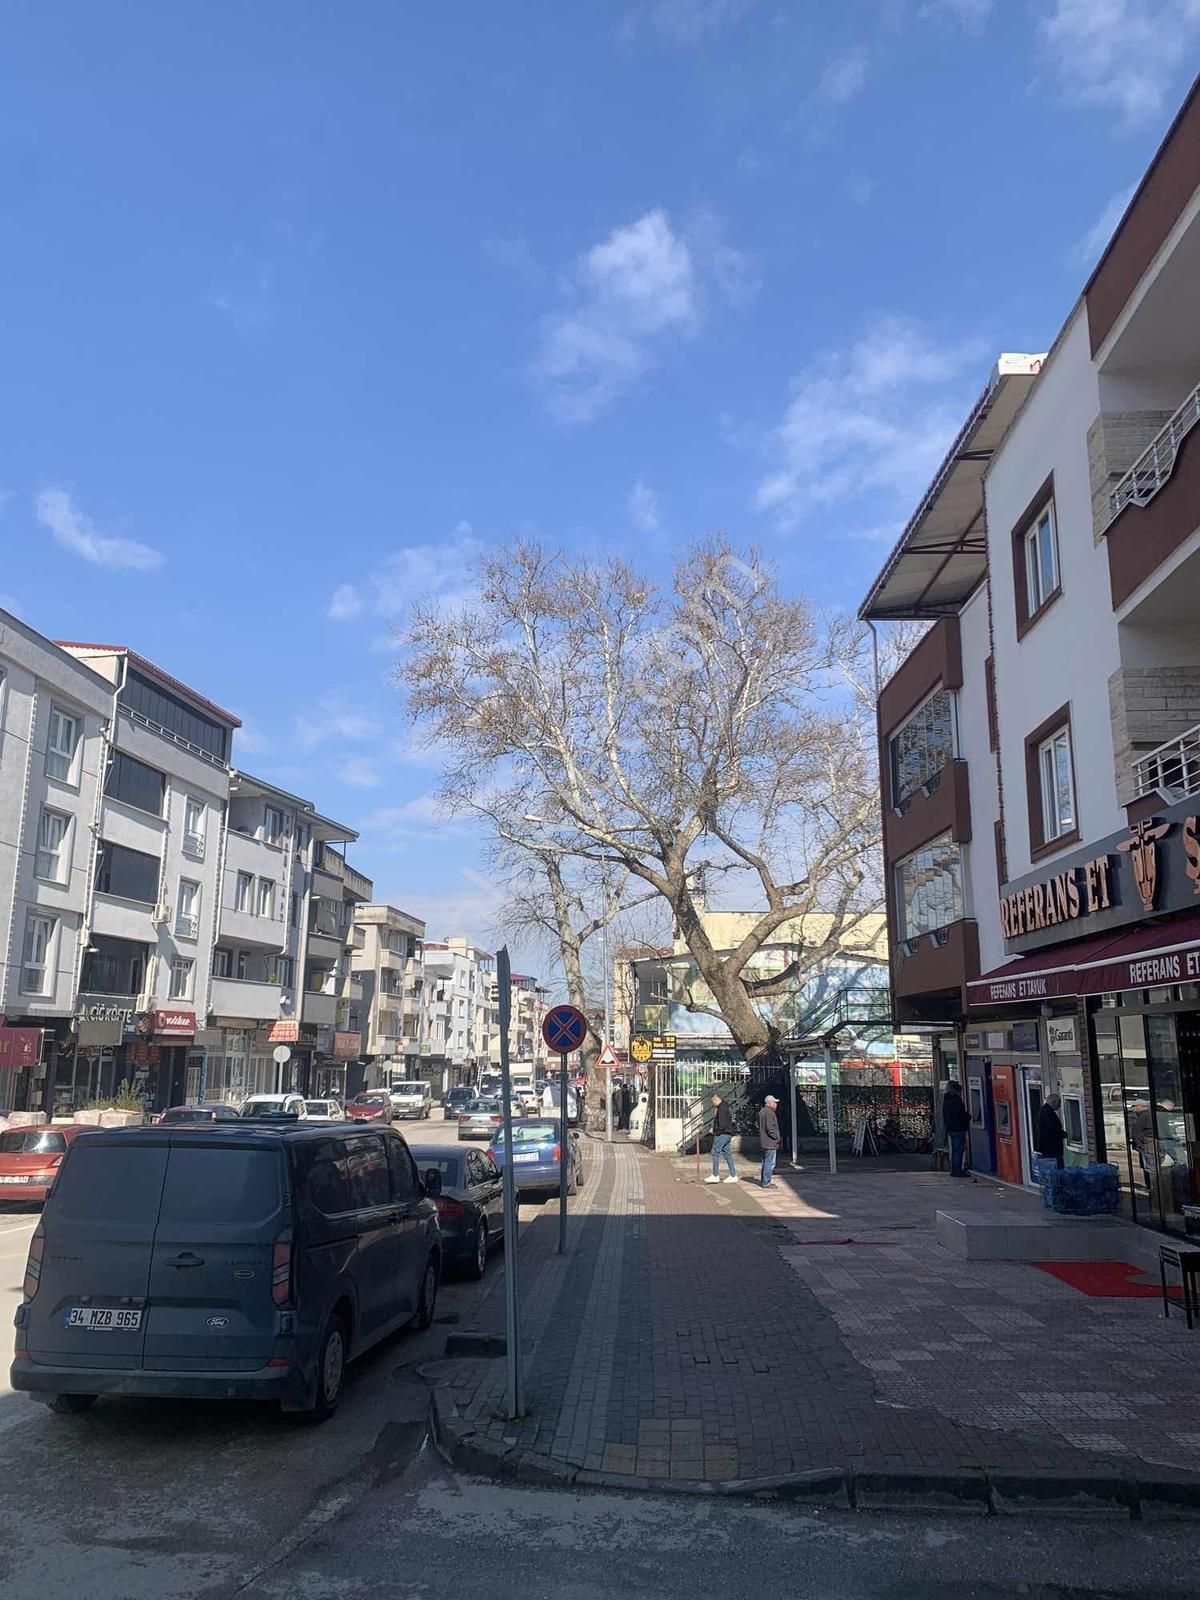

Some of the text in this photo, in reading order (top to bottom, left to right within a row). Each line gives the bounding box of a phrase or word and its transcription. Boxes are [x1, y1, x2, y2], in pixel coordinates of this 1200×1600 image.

[1000, 854, 1111, 939] REFERANS ET
[1130, 954, 1181, 984] REFERANS
[990, 981, 1017, 999] REFERANS
[1018, 980, 1027, 997] ET
[70, 1309, 139, 1327] 34 MZB 965
